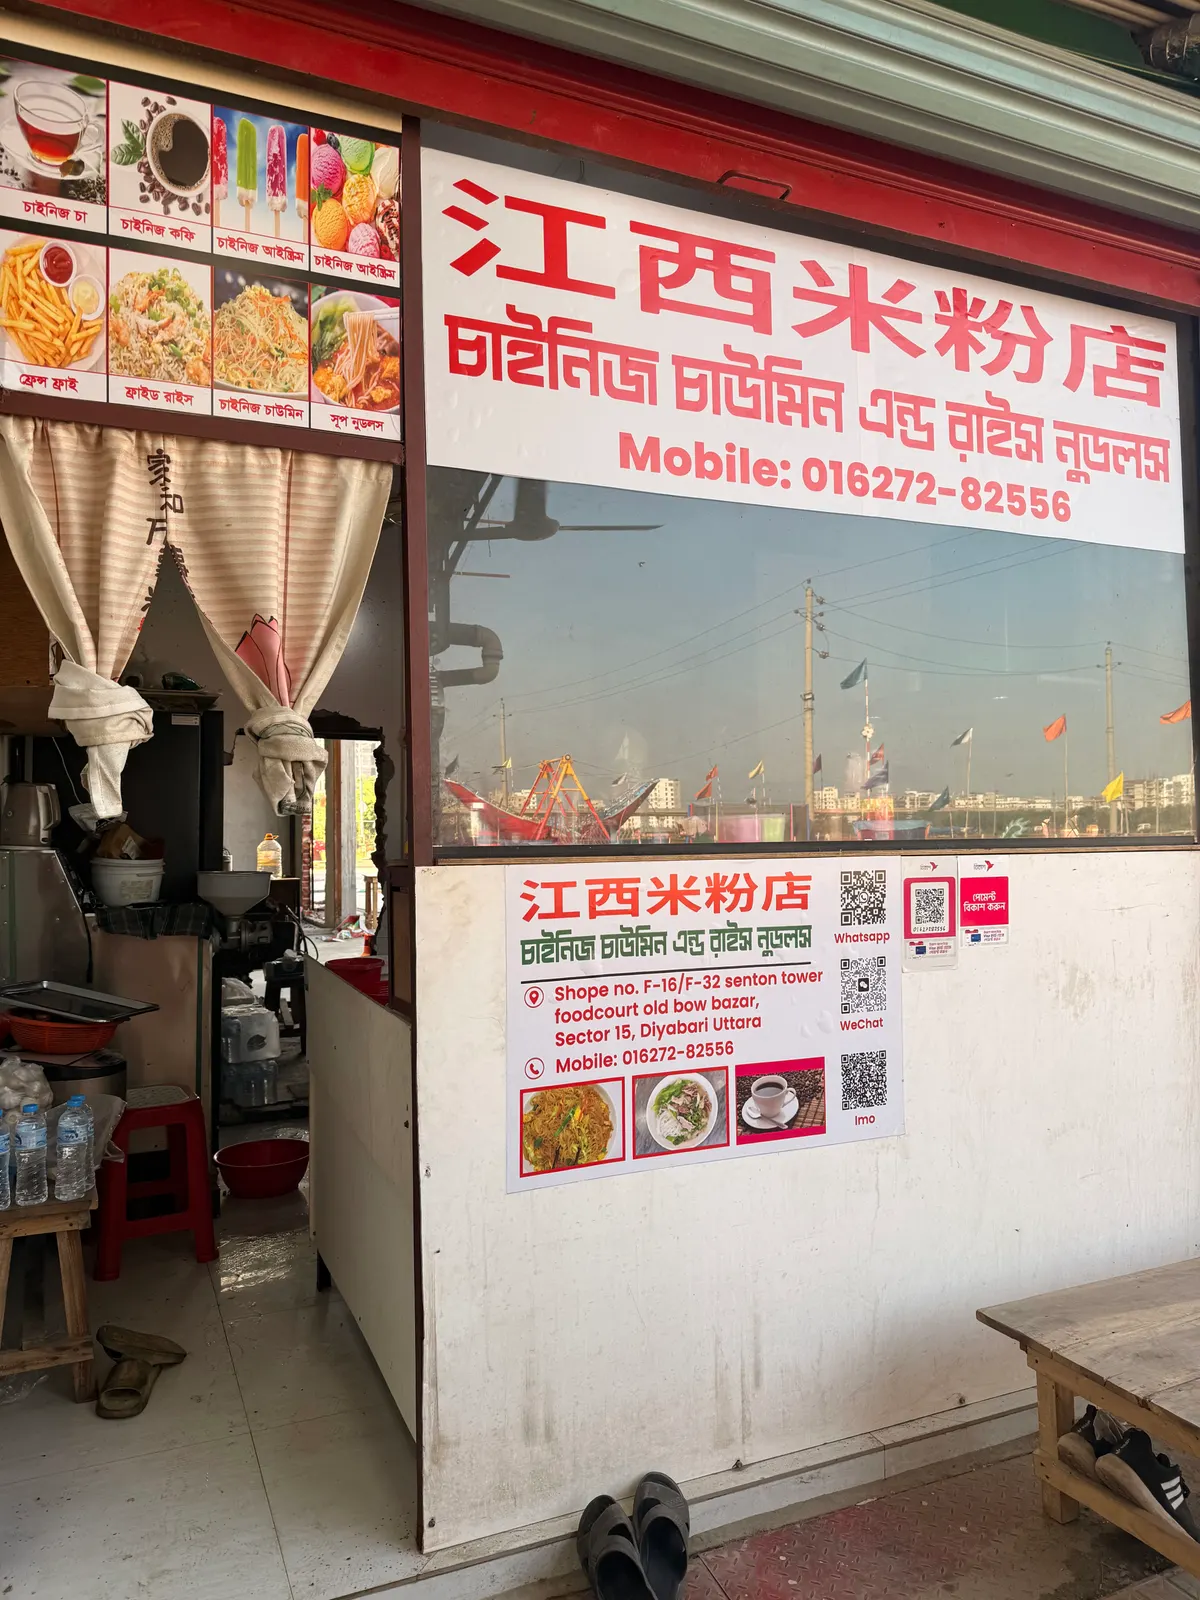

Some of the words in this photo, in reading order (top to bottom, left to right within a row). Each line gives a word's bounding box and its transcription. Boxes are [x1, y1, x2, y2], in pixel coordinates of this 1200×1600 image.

[22, 200, 71, 221] চাইনিজ
[74, 210, 88, 223] চা
[120, 217, 165, 237] চাইনিজ
[169, 226, 196, 242] কফি
[216, 236, 259, 254] চাইনিজ
[313, 253, 353, 272] চাইনিজ
[442, 179, 1167, 408] 江西米粉店
[52, 376, 79, 393] ফ্রাই
[125, 384, 160, 401] ফ্রাইড
[163, 389, 195, 406] রাইস
[443, 303, 659, 406] চাইনিজ
[671, 344, 845, 433] চাউমিন
[945, 390, 1044, 464] রাইস
[1053, 420, 1170, 485] নুডলস
[219, 397, 261, 415] চাইনিজ
[264, 403, 304, 421] চাউমিন
[351, 416, 384, 432] নুডলস
[618, 431, 792, 490] Mobile:
[802, 457, 1072, 523] 016272-82556
[519, 871, 813, 923] 江西米粉店
[963, 901, 986, 912] বিকাশ
[987, 902, 1006, 912] করুন
[972, 891, 997, 902] পেমেন্ট
[520, 929, 596, 966] চাইনিজ
[600, 925, 667, 960] চাউমিন
[709, 920, 753, 958] রাইস
[757, 924, 812, 957] নুডলস
[834, 930, 891, 944] Whatsapp
[554, 984, 610, 1003] Shope
[613, 982, 640, 997] no.
[643, 972, 722, 995] F-16/F-32
[725, 972, 778, 990] senton
[781, 969, 824, 985] tower
[554, 1003, 640, 1024] foodcourt
[643, 999, 669, 1016] old
[672, 996, 707, 1014] bow
[711, 993, 760, 1011] bazar,
[555, 1025, 611, 1047] Sector
[614, 1025, 636, 1043] 15,
[640, 1016, 709, 1041] Diyabari
[713, 1014, 763, 1031] Uttara
[839, 1016, 884, 1032] WeChat
[555, 1051, 618, 1074] Mobile:
[622, 1041, 735, 1067] 016272-82556
[854, 1114, 876, 1126] Imo
